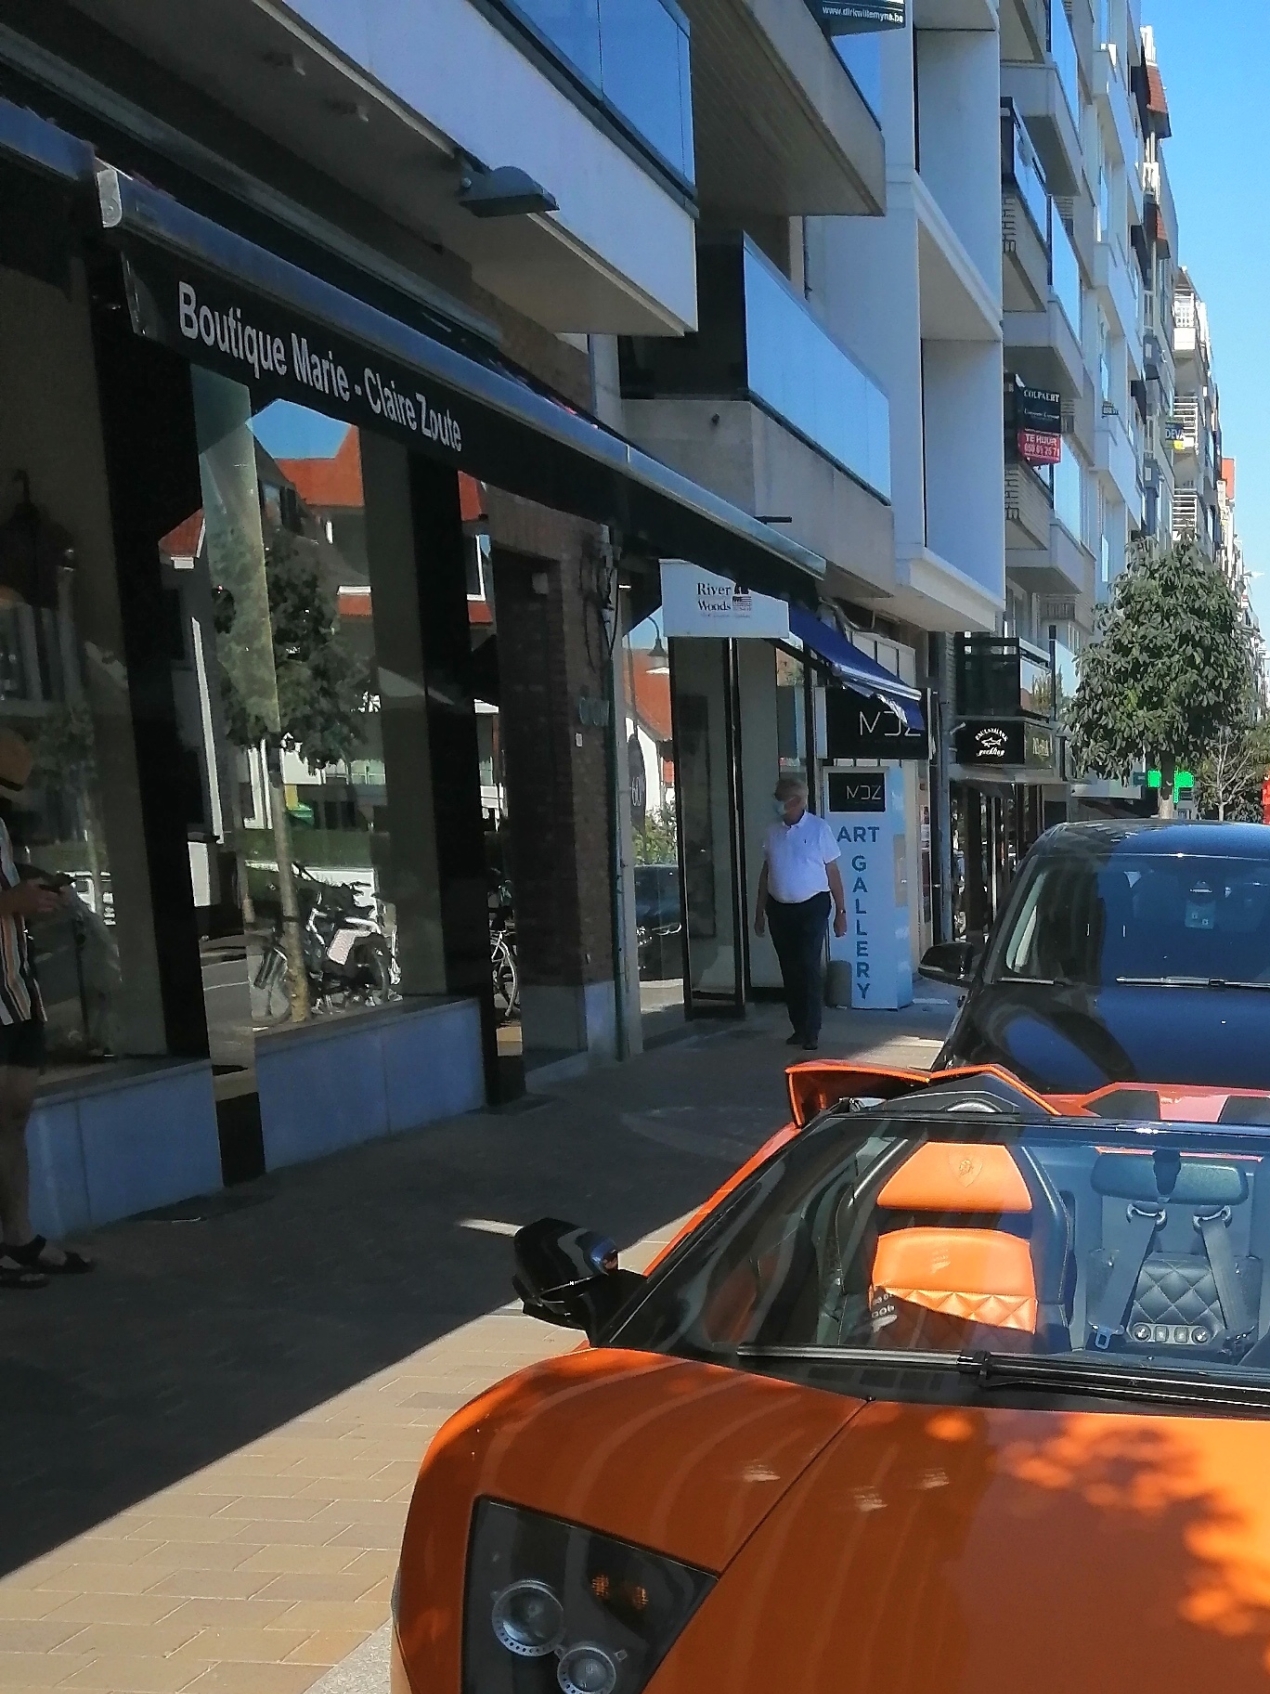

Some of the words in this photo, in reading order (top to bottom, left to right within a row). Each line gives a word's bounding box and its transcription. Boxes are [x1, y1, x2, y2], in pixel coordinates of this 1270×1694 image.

[179, 281, 287, 379] Boutique
[291, 332, 350, 401] Marie
[363, 368, 417, 431] Claire
[416, 393, 462, 452] Zoute
[1025, 433, 1036, 442] TE
[1036, 436, 1057, 447] HUUR
[697, 582, 732, 596] River
[698, 600, 732, 612] Woods
[837, 825, 880, 843] ART
[851, 854, 871, 1000] GALLERY
